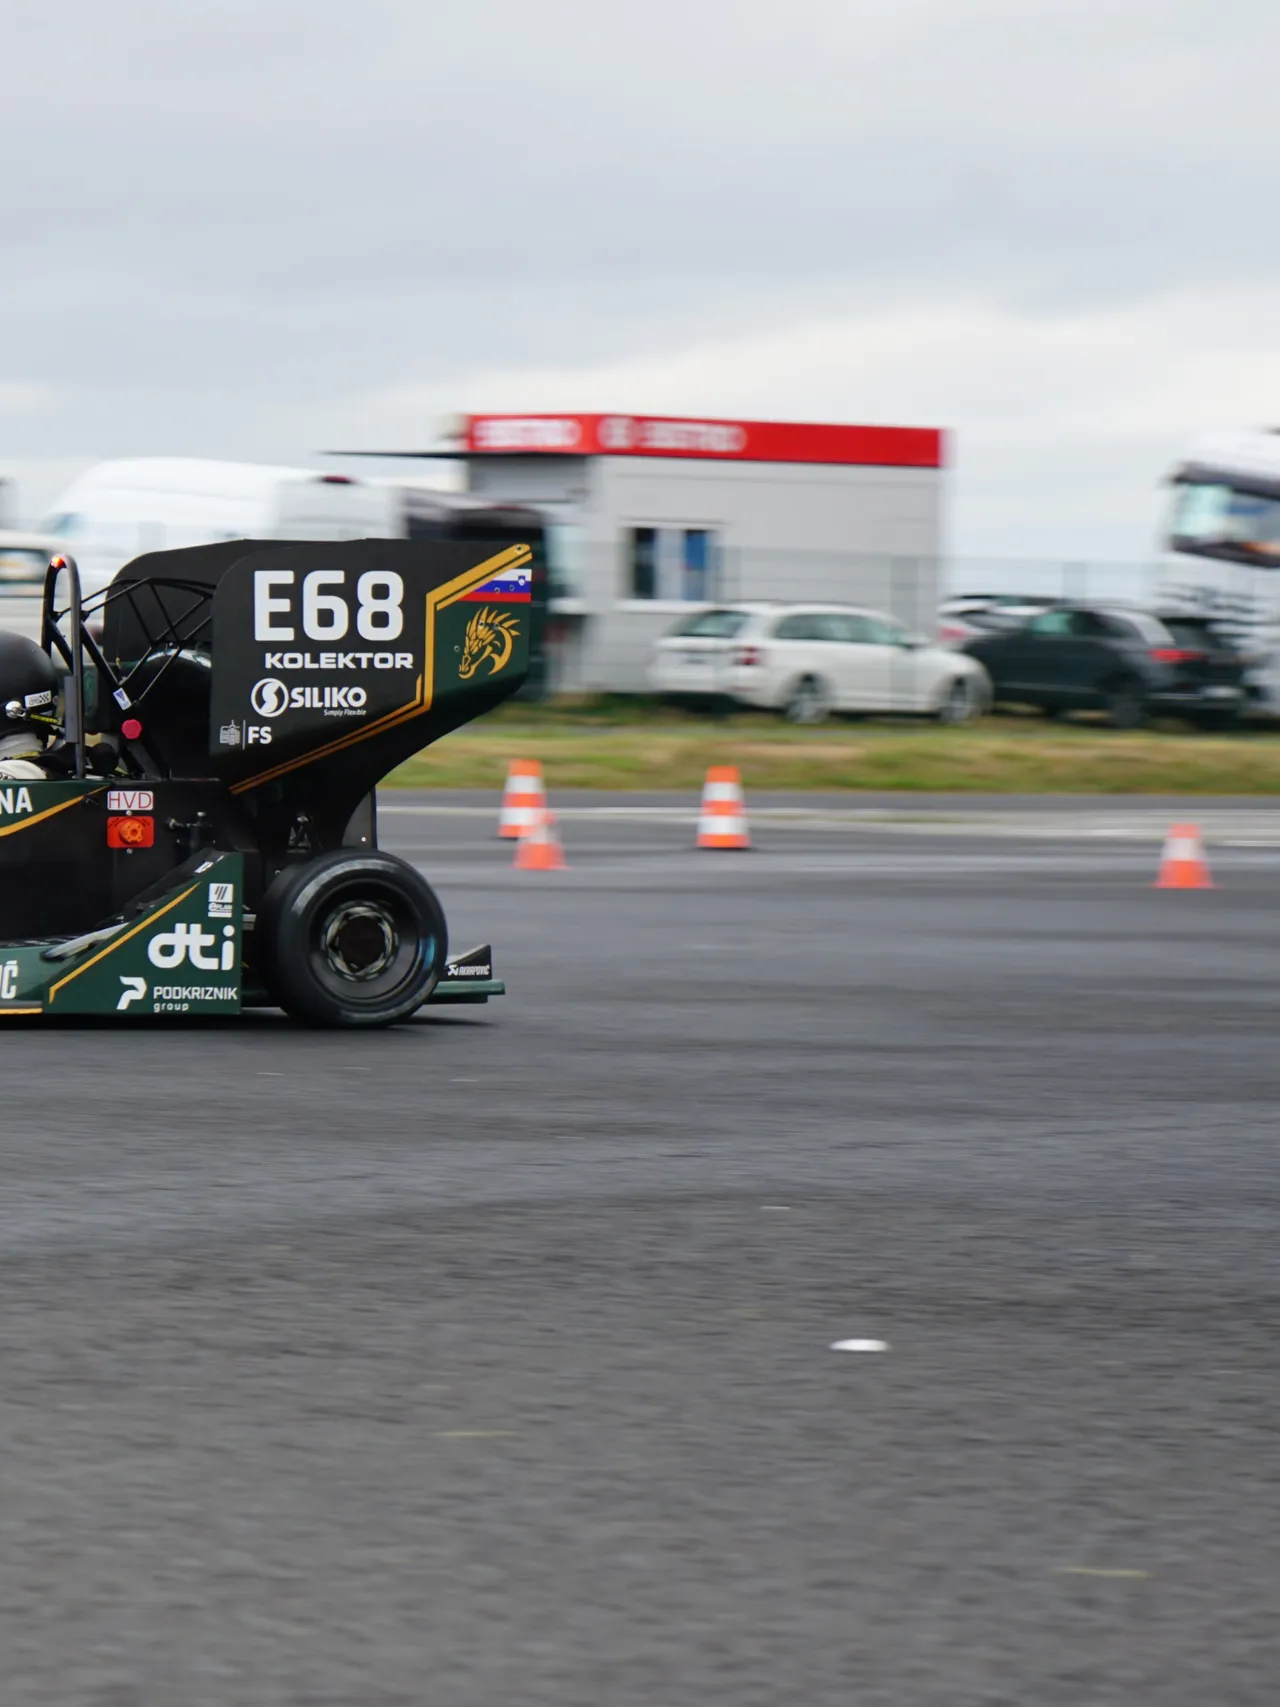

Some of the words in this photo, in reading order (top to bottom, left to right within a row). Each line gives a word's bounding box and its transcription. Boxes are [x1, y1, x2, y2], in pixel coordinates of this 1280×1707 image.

[254, 570, 404, 641] E68
[265, 653, 413, 669] KOLEKTOR
[289, 687, 367, 708] SILIKO
[248, 726, 272, 744] FS
[108, 792, 152, 808] HVD
[147, 923, 235, 971] dti
[153, 987, 238, 1000] PODKRIZNIK
[153, 1002, 189, 1013] group
